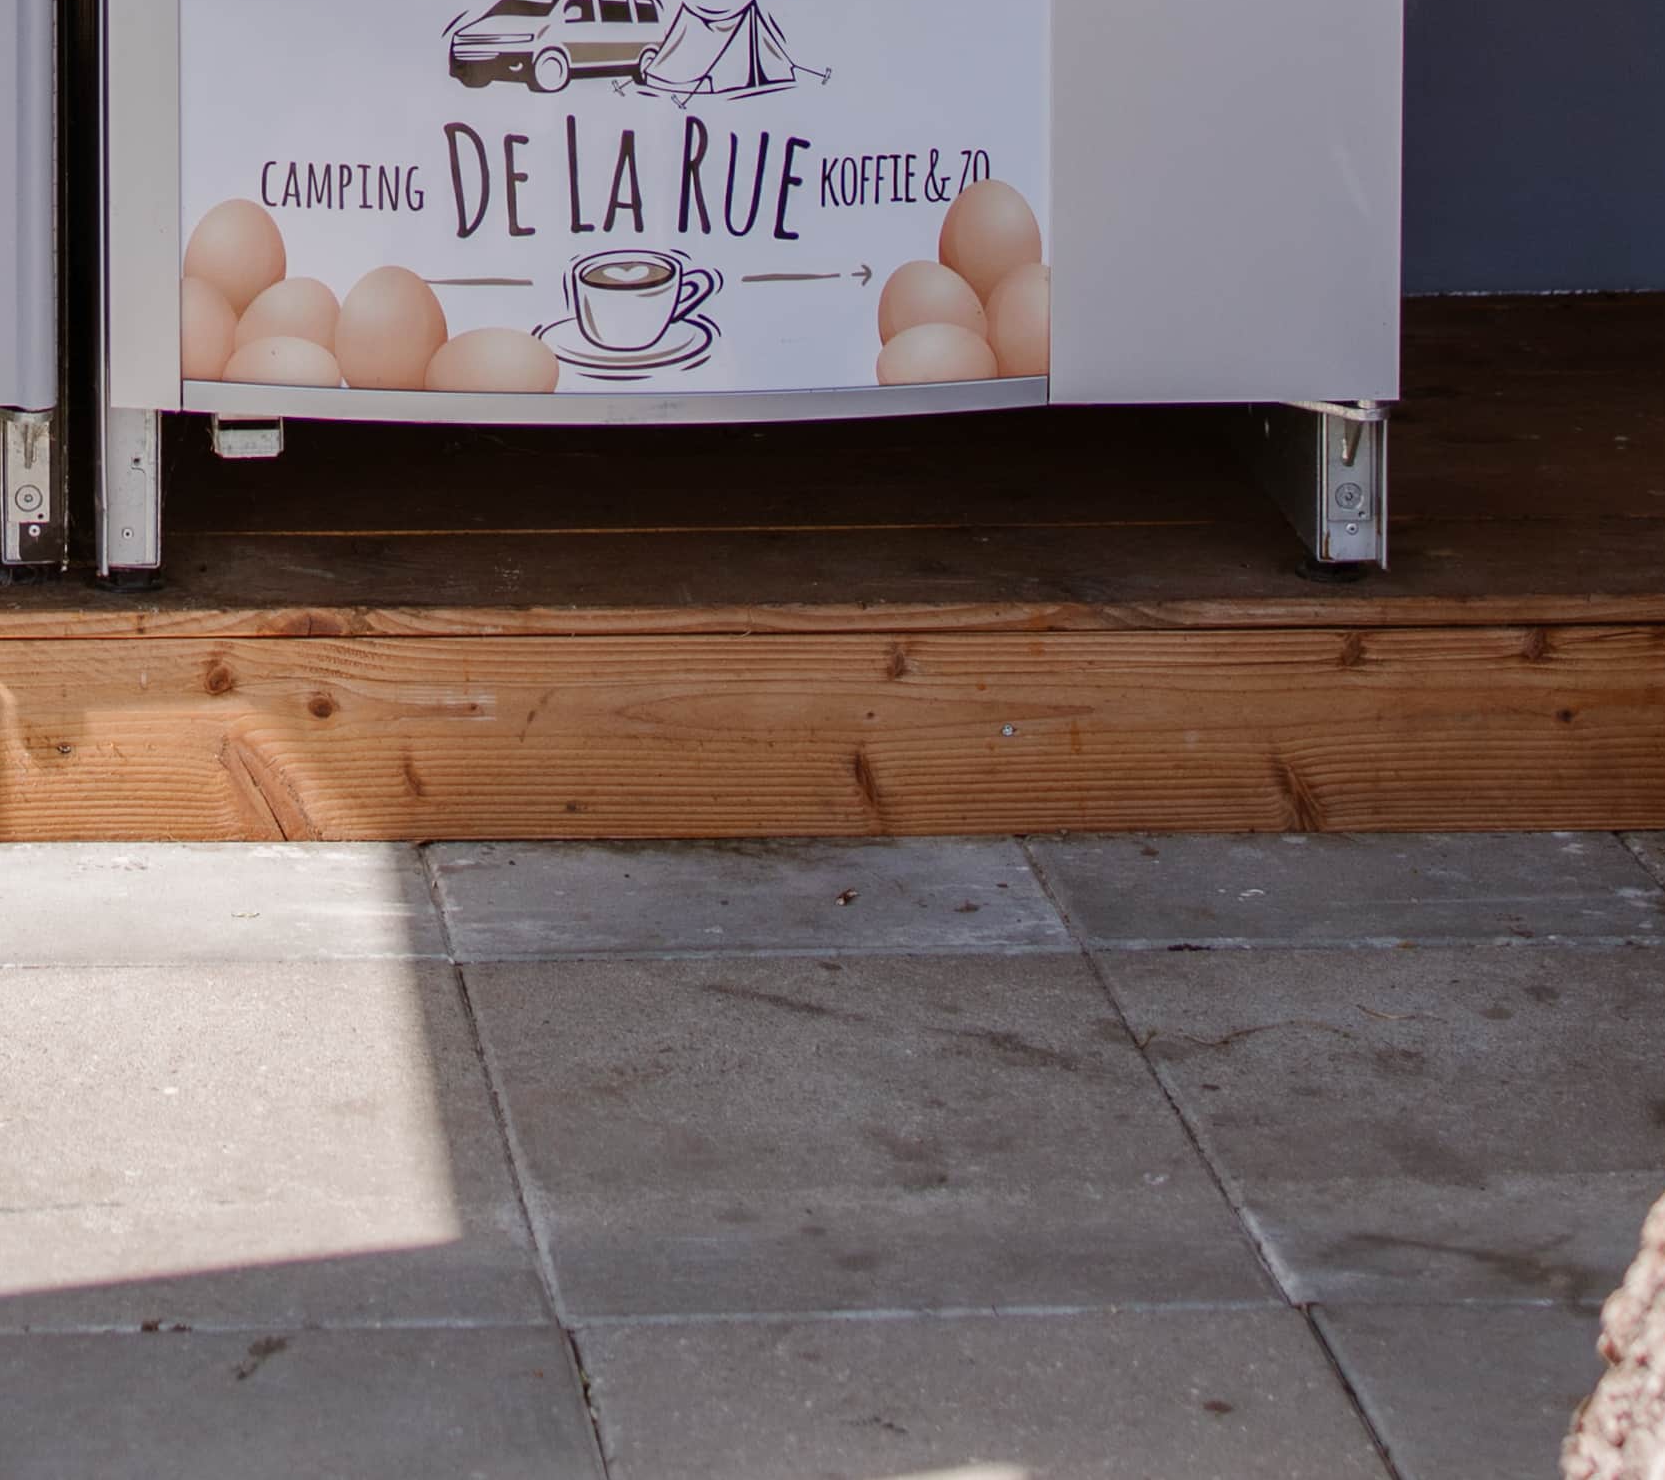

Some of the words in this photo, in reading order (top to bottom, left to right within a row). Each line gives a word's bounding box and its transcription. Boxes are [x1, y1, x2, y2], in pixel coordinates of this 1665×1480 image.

[261, 160, 425, 213] CAMPING
[443, 122, 537, 240] DE
[565, 114, 645, 235] LA
[677, 115, 811, 242] RUE
[820, 153, 917, 208] KOFFIE
[924, 148, 952, 203] &
